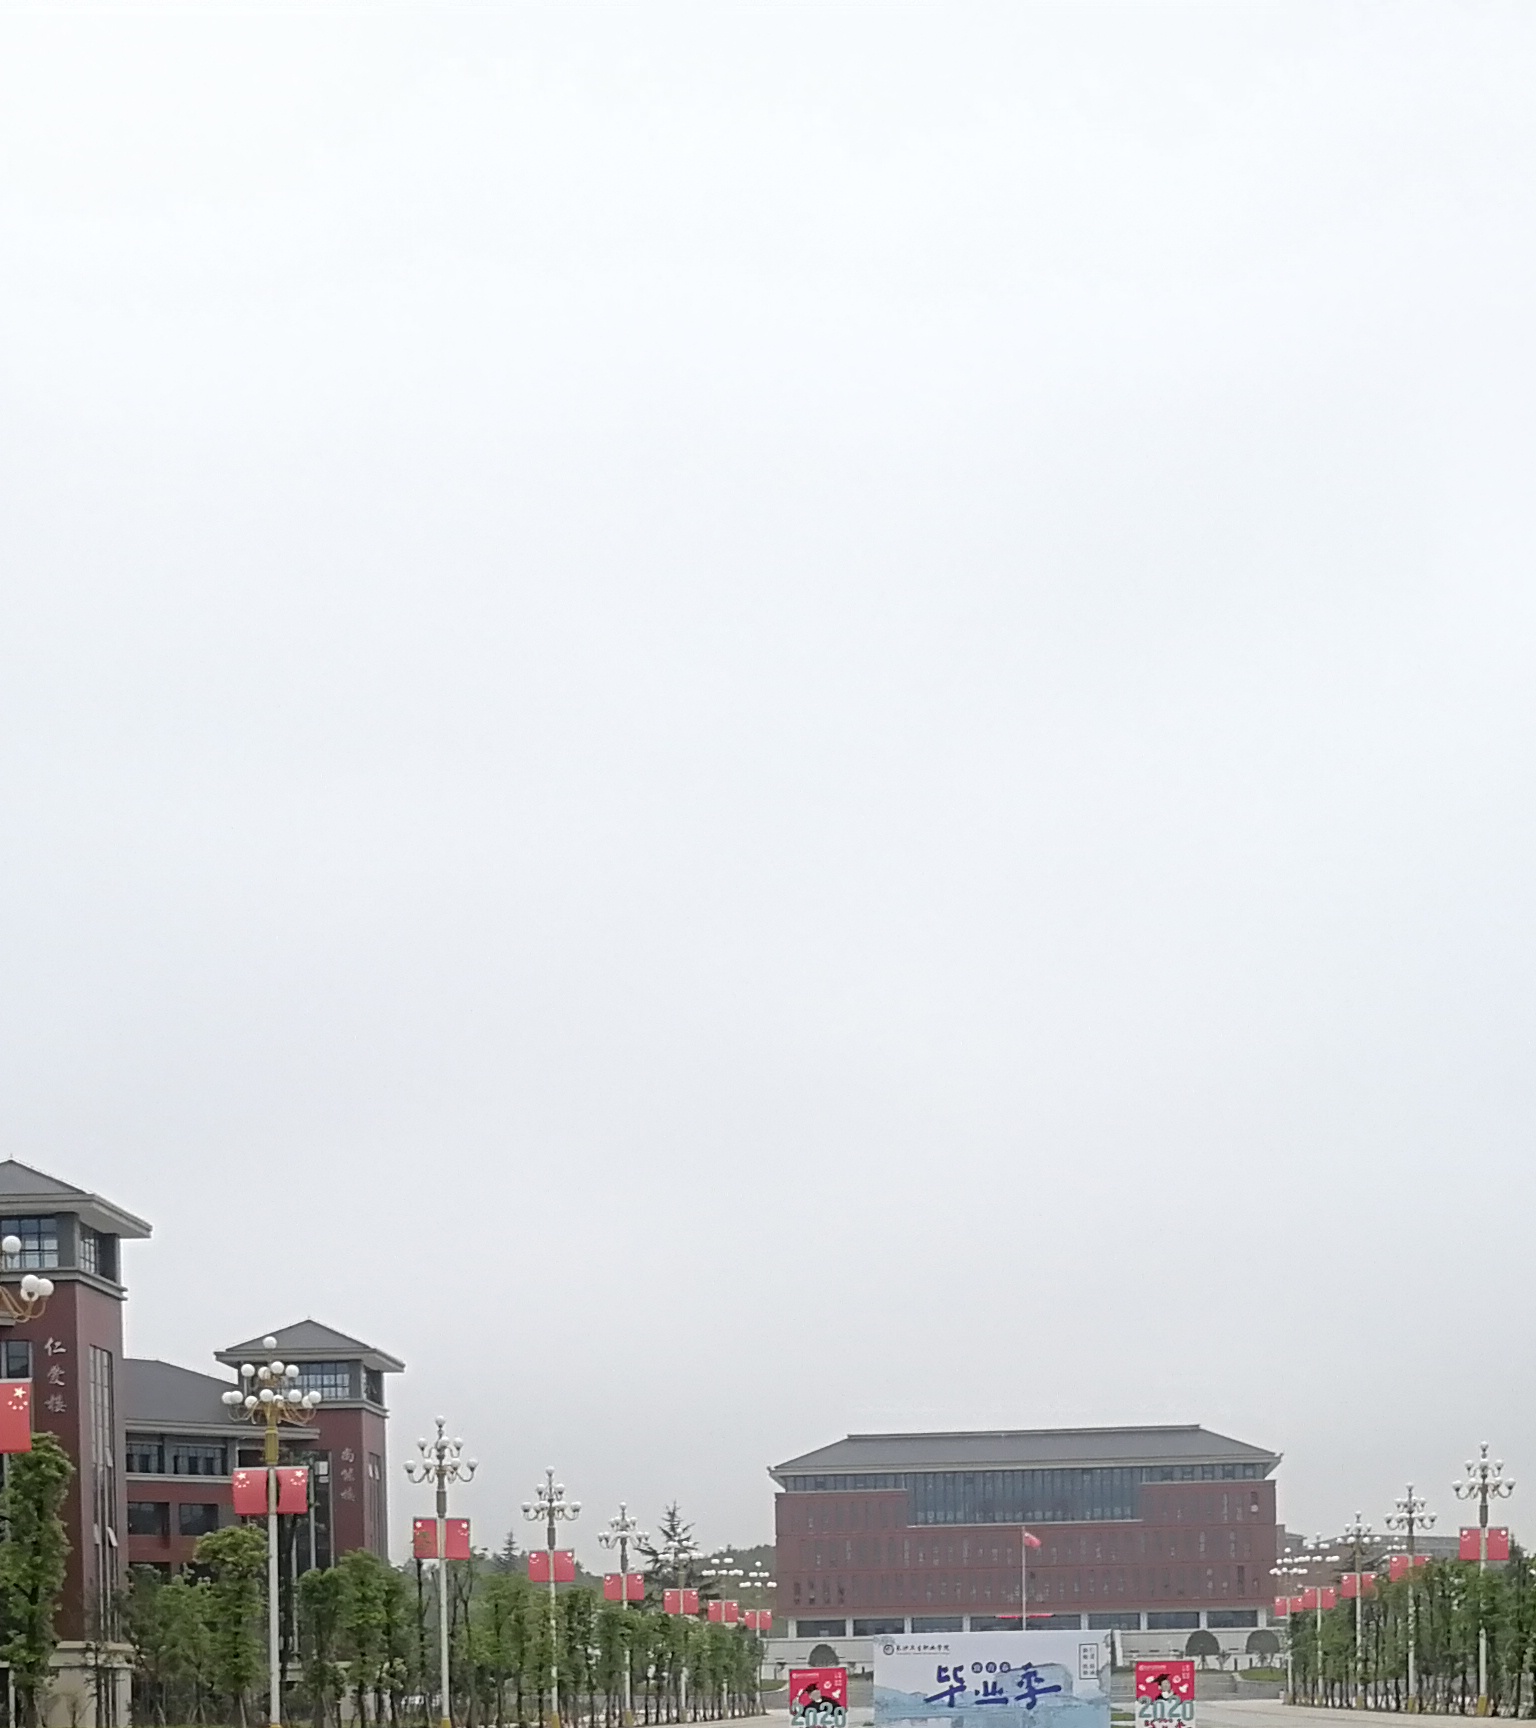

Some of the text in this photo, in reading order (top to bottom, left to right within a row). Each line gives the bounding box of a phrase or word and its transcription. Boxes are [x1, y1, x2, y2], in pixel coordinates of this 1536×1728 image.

[923, 1661, 1062, 1710] 毕业季
[791, 1702, 846, 1728] 2020
[1138, 1695, 1194, 1721] 2020
